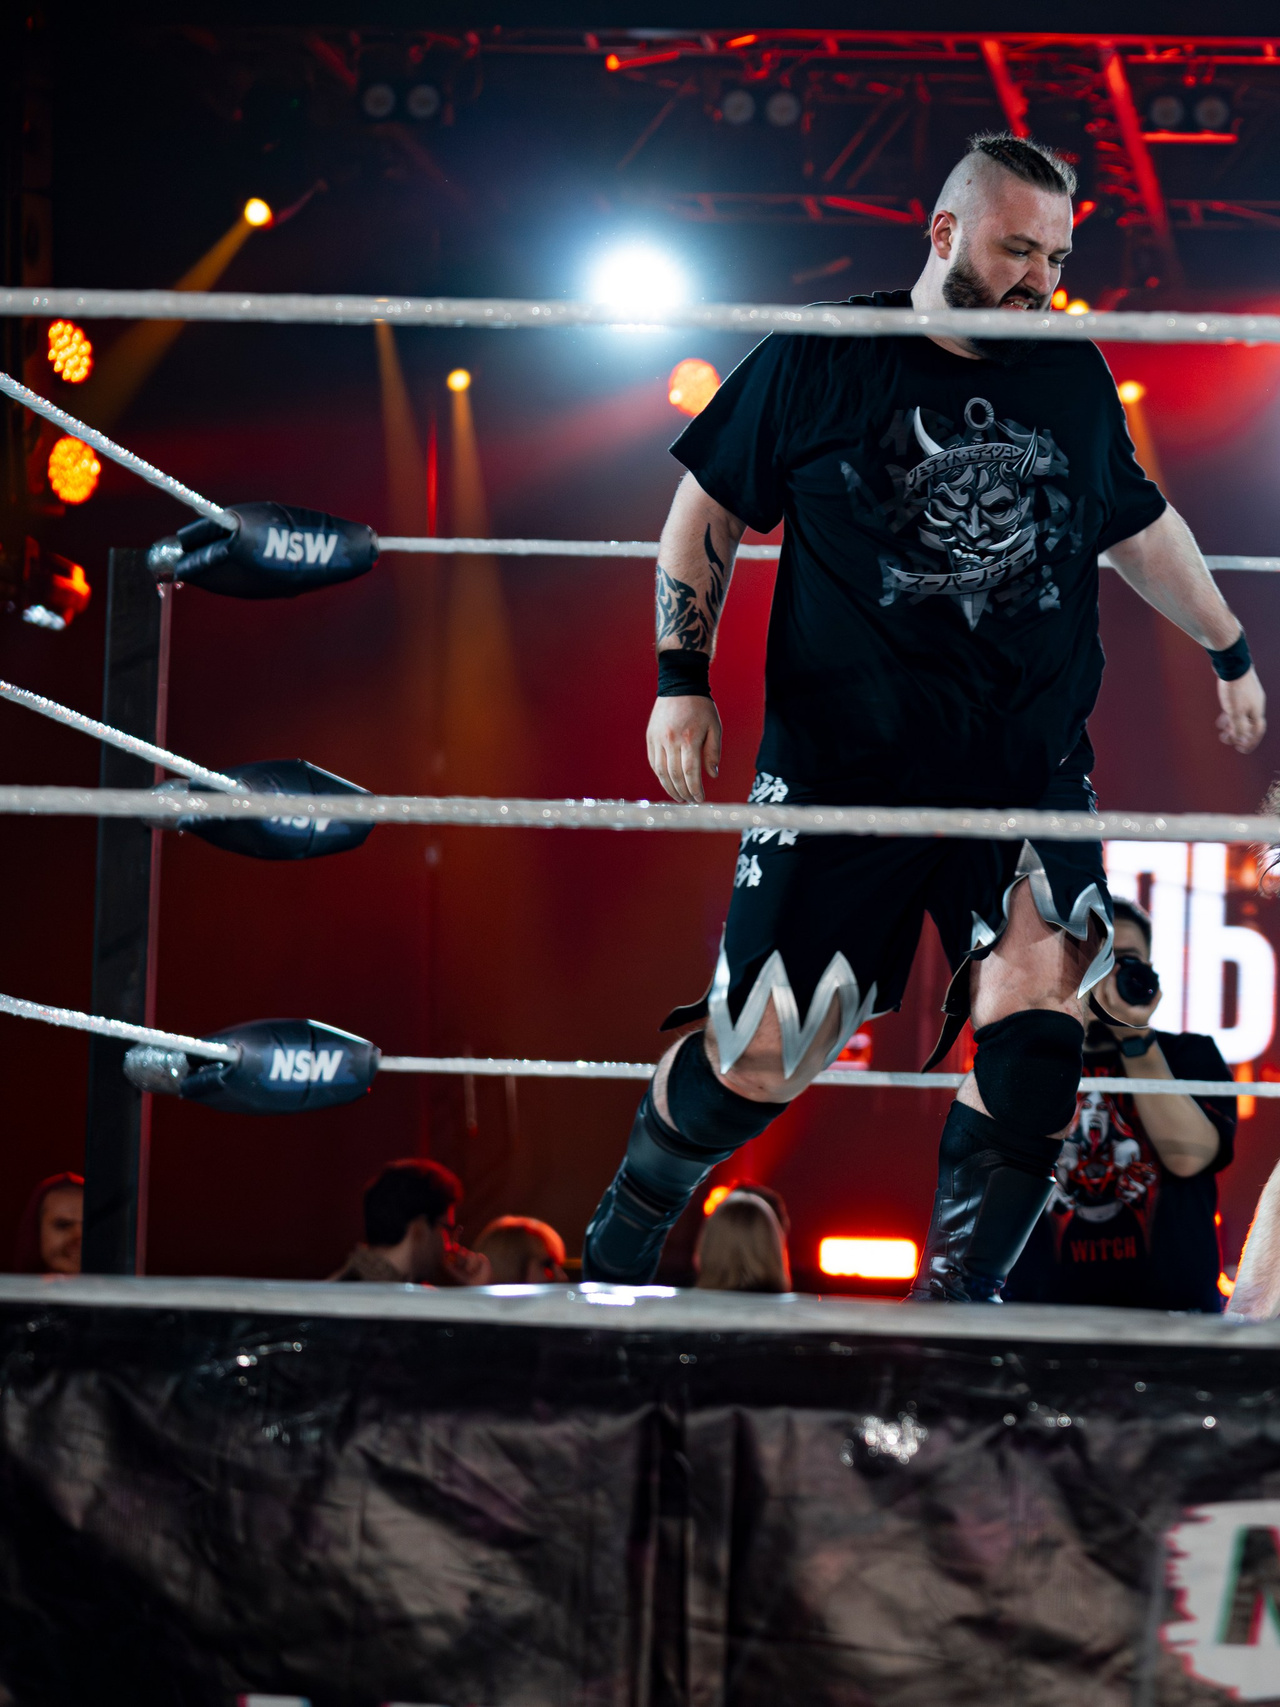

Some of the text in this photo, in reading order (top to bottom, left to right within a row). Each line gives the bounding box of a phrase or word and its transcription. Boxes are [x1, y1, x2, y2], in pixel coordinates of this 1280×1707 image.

[262, 526, 339, 566] NSW
[269, 1048, 344, 1083] NSW
[1070, 1236, 1137, 1264] WITCH
